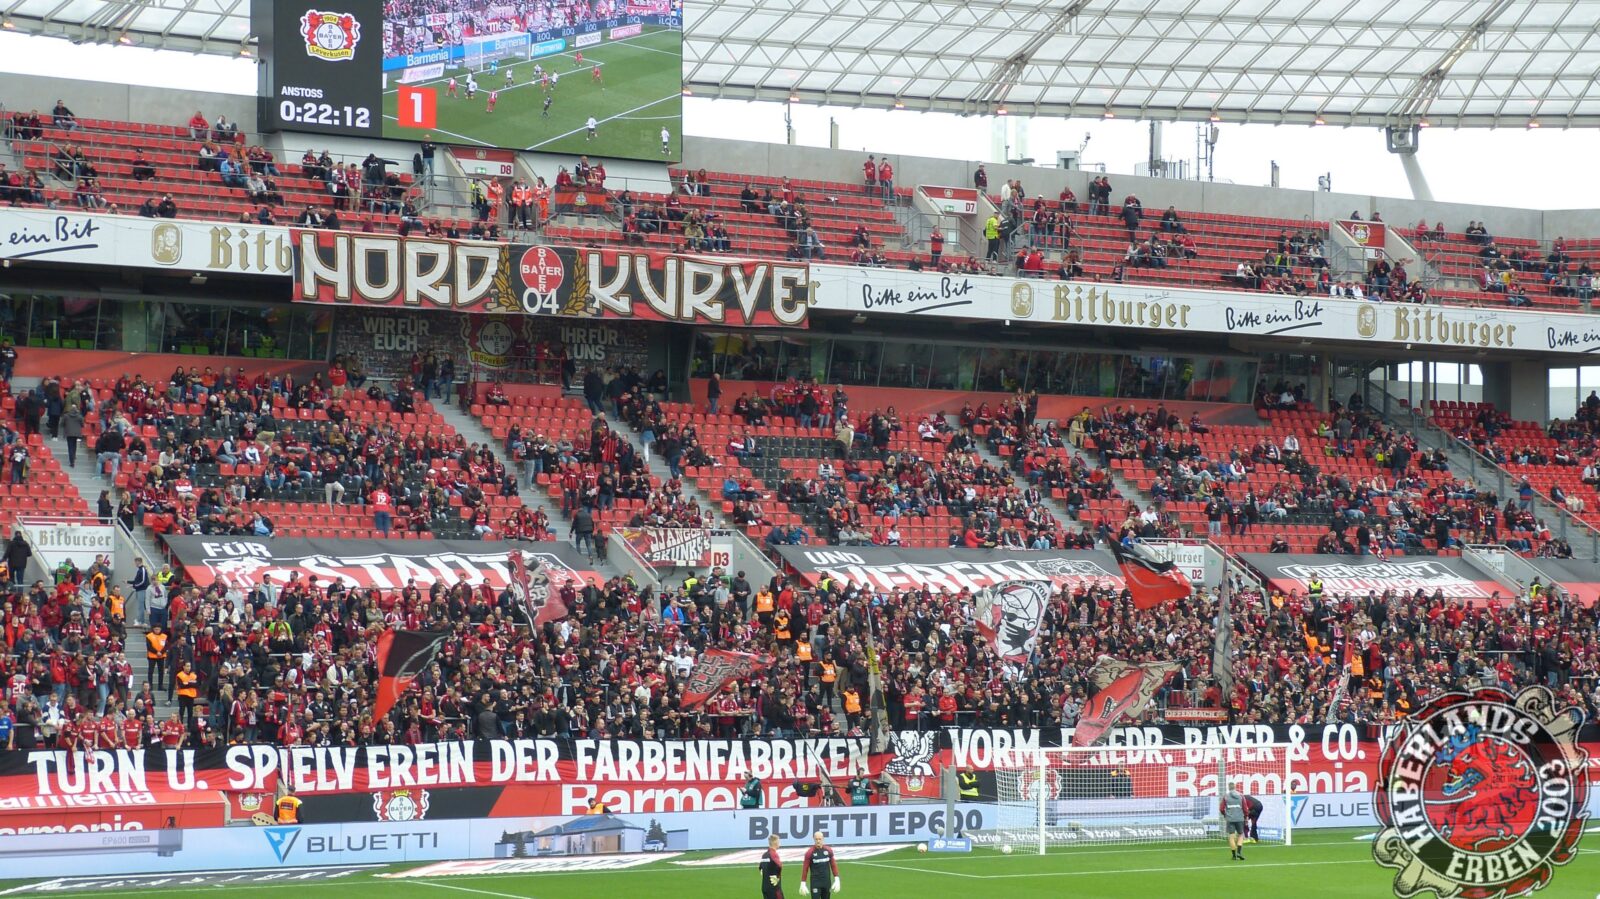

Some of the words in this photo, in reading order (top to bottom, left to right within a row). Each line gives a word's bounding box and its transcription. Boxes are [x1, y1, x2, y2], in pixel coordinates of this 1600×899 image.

[406, 50, 449, 67] Barmenia
[281, 86, 323, 98] ANSTOSS
[280, 100, 370, 128] 0:22:12
[410, 92, 424, 123] 1
[500, 164, 512, 175] D8
[965, 202, 975, 213] D7
[8, 230, 51, 244] ein
[55, 216, 99, 242] Bit
[522, 264, 562, 276] BAYER
[586, 251, 808, 325] KURVE
[862, 283, 903, 308] Bitte
[907, 287, 938, 302] ein
[941, 277, 973, 296] Bit
[522, 287, 560, 315] 04
[1052, 285, 1192, 328] Bitburger
[1225, 307, 1262, 330] Bitte
[1265, 312, 1292, 325] ein
[1294, 299, 1324, 319] Bit
[362, 317, 398, 335] WIR
[400, 316, 430, 336] FÜR
[1392, 306, 1518, 347] Bitburger
[374, 333, 418, 351] EUCH
[561, 327, 587, 344] IHR
[588, 326, 618, 345] FÜR
[1547, 327, 1580, 349] Bitte
[574, 344, 605, 361] UNS
[38, 529, 112, 547] Bitburger
[202, 541, 273, 558] FÜR
[803, 550, 866, 565] UND
[713, 552, 729, 567] D3
[1192, 568, 1203, 580] D2
[12, 682, 25, 694] 20
[27, 750, 148, 796] TURN
[166, 749, 208, 791] U.
[490, 738, 560, 783] DER
[575, 736, 871, 782] FARBENFABRIKEN
[1184, 724, 1276, 764] BAYER
[1288, 724, 1310, 762] &
[1321, 723, 1366, 761] CO.
[1167, 762, 1368, 797] Barmenia
[390, 805, 413, 813] BAYER
[748, 813, 878, 840] BLUETTI
[889, 808, 984, 837] EP600
[1053, 829, 1078, 841] trive
[1095, 828, 1121, 839] trive
[1137, 827, 1164, 838] trive
[1179, 825, 1205, 837] trive
[102, 835, 127, 846] EP600
[306, 832, 439, 854] BLUETTI
